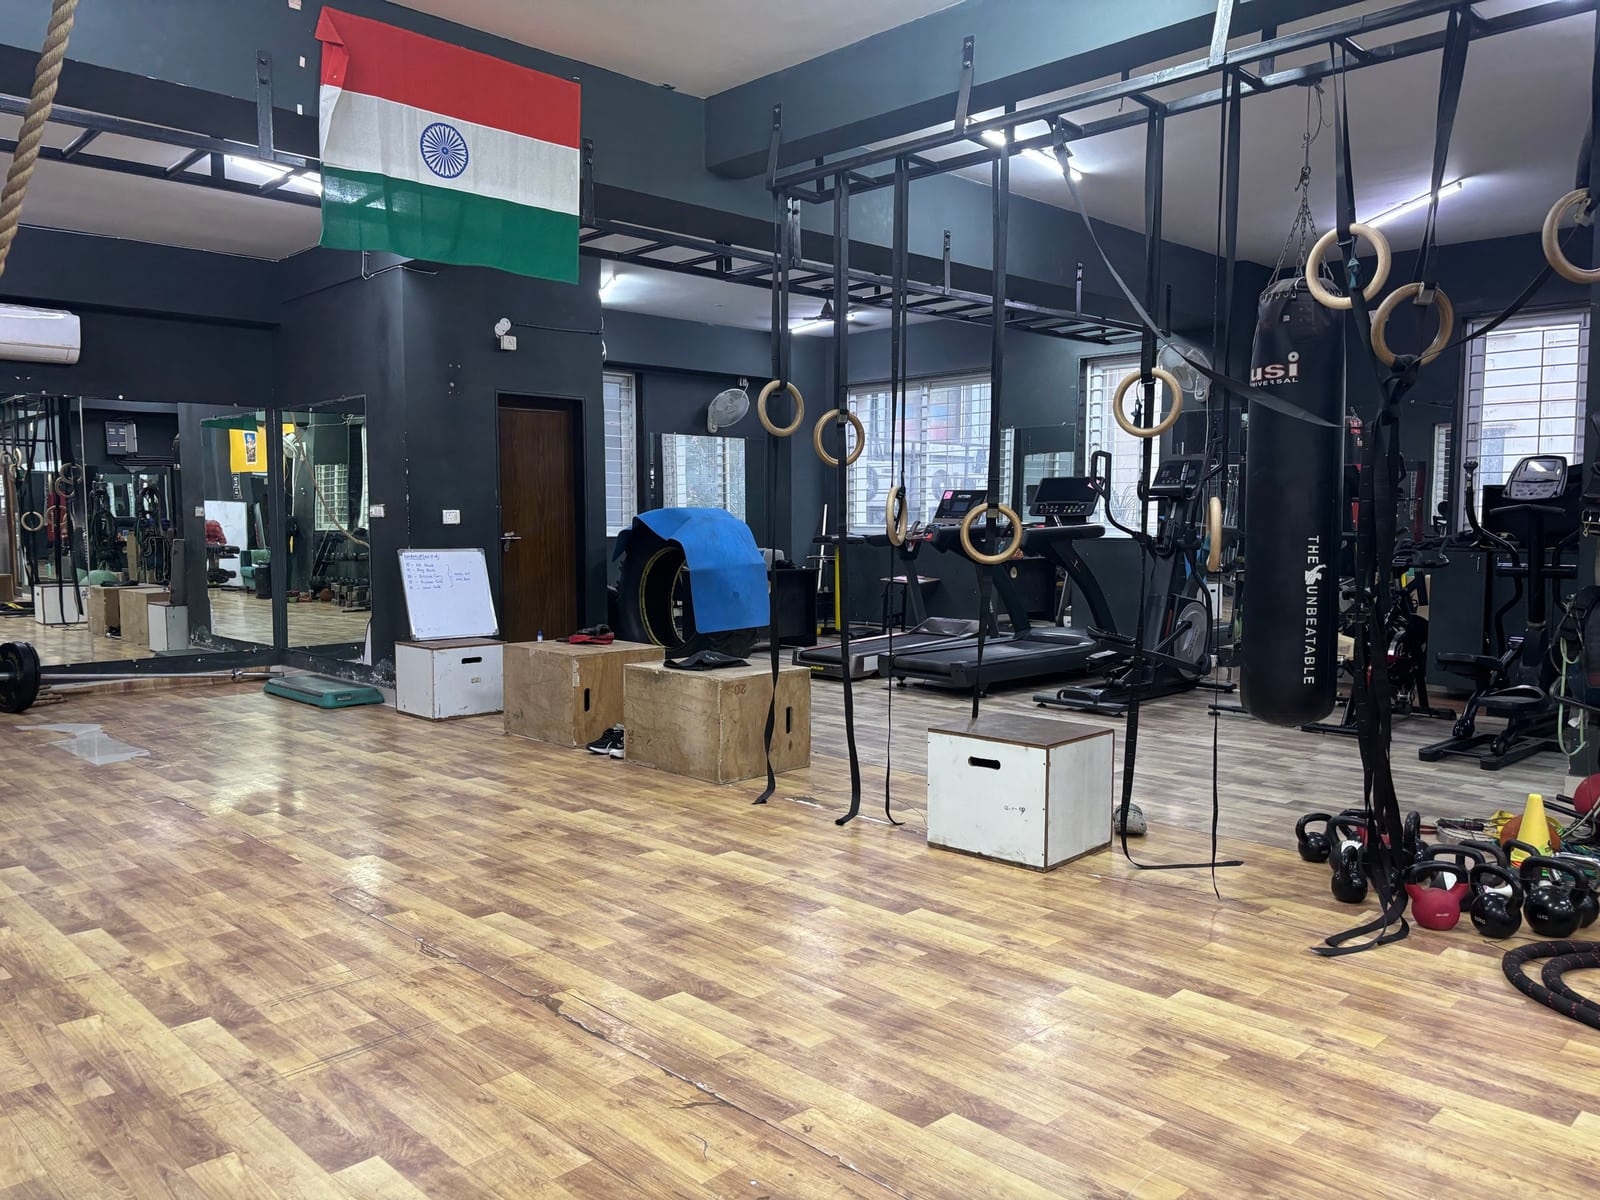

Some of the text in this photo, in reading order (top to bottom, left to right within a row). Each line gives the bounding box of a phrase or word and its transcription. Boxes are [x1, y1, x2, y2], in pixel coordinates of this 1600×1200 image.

[1251, 351, 1299, 381] usi
[1304, 536, 1320, 684] THE UNBEATABLE
